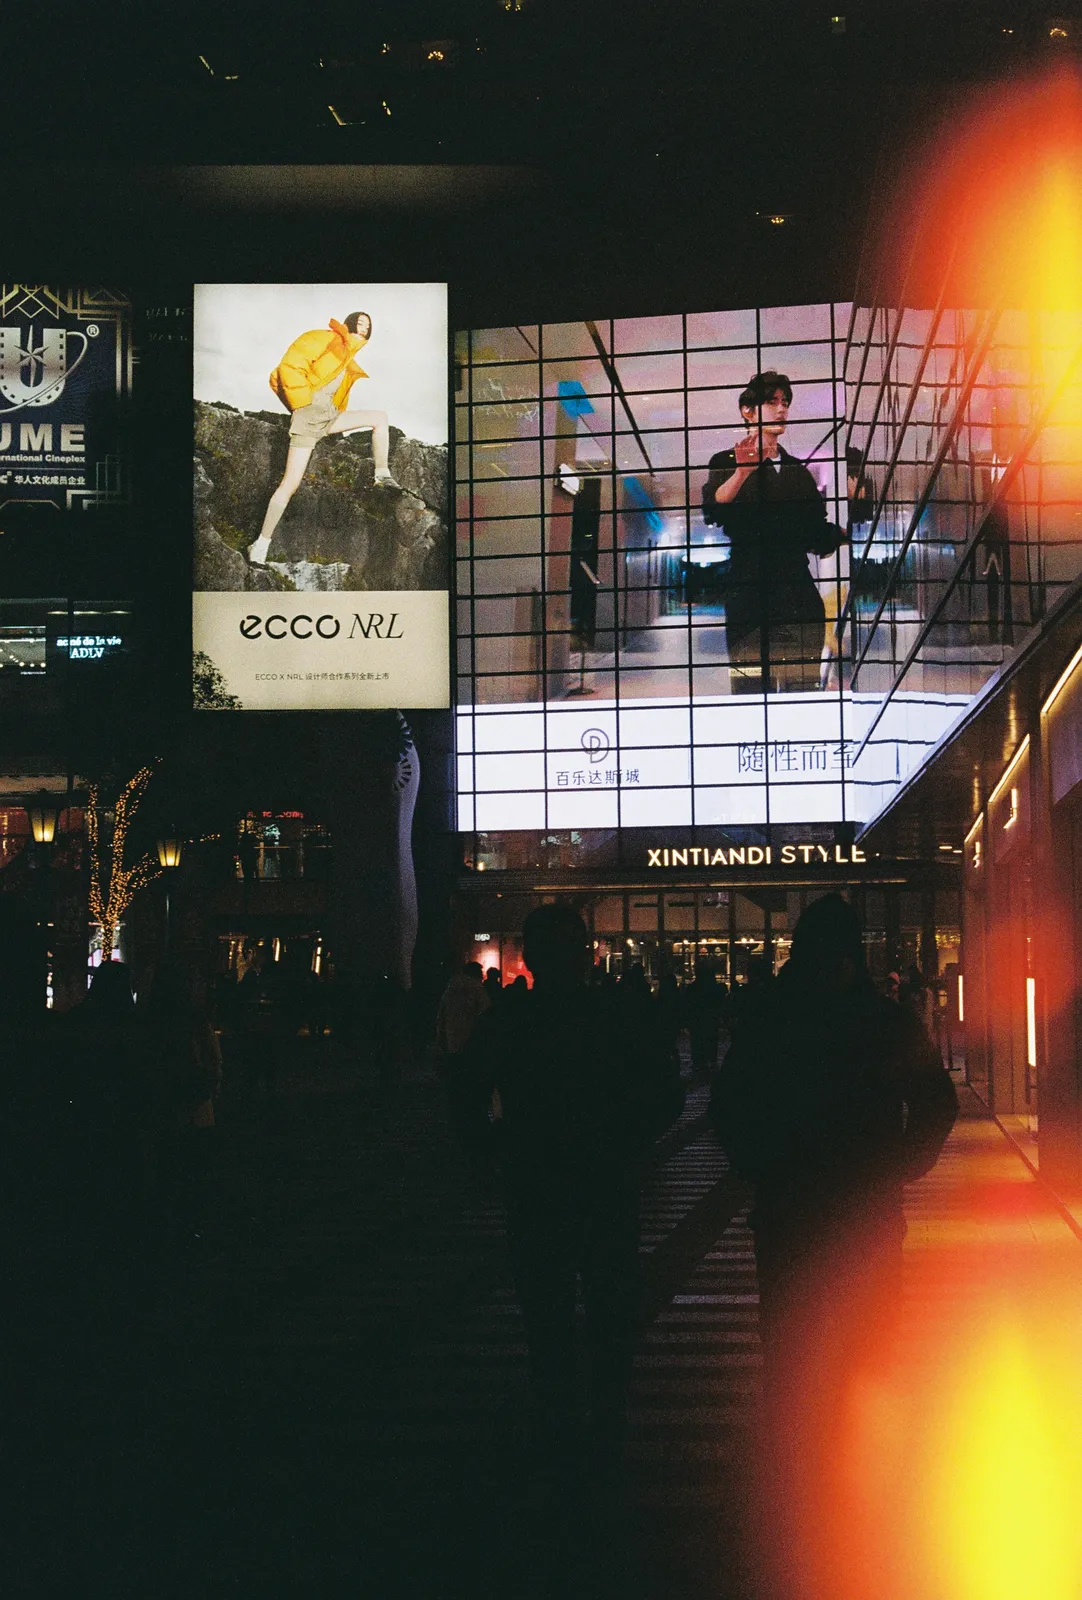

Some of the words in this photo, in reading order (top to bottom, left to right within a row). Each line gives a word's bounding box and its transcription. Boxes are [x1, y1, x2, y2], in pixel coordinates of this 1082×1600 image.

[0, 454, 43, 462] rnational
[45, 454, 86, 463] Cineplex
[14, 475, 86, 485] 华人文化成员企业
[347, 613, 405, 639] NRL
[106, 635, 122, 646] vie
[70, 647, 105, 659] ADLV
[255, 673, 278, 681] ECCO
[286, 673, 303, 681] NRL
[305, 672, 390, 681] 设计师合作系列全新上市
[737, 739, 854, 774] 随性而至
[556, 768, 640, 786] 百乐达斯城
[647, 846, 772, 867] XINTIANDI
[780, 844, 867, 865] STYLE
